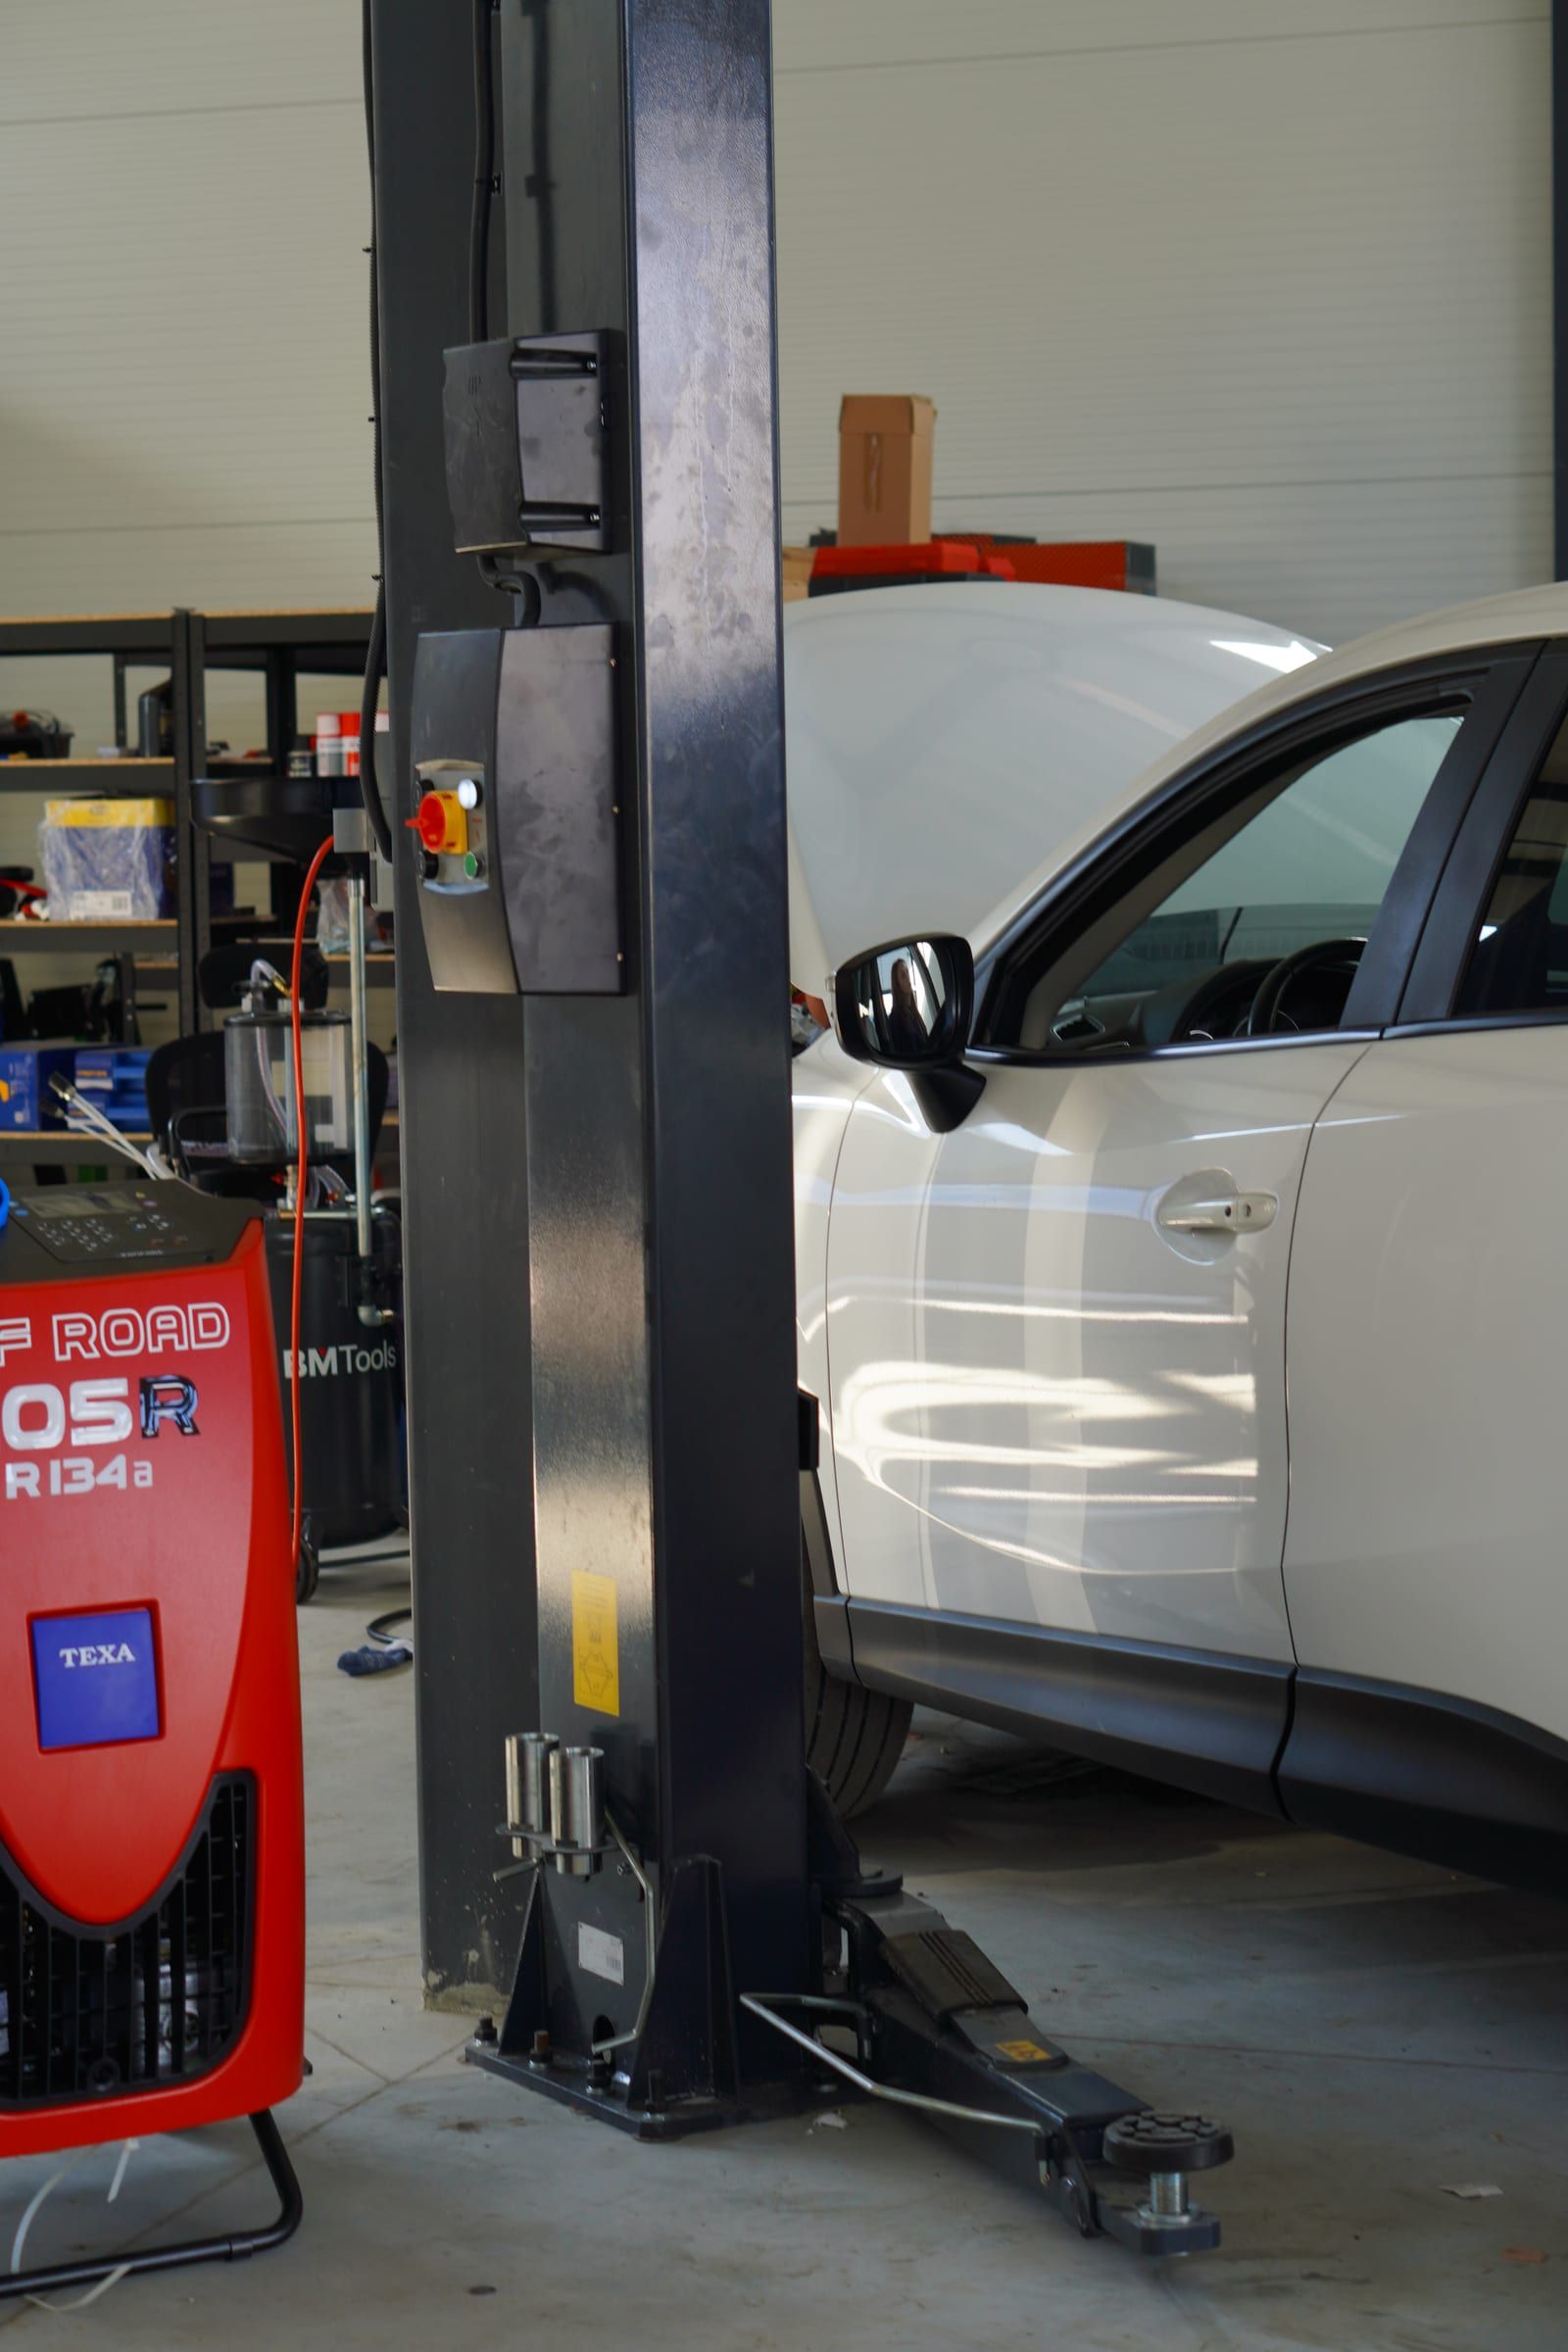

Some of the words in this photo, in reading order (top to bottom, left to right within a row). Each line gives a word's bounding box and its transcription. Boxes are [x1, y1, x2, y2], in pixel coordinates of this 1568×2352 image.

[52, 1302, 230, 1361] ROAD
[5, 1453, 153, 1499] R134a
[59, 1642, 135, 1668] TEXA
